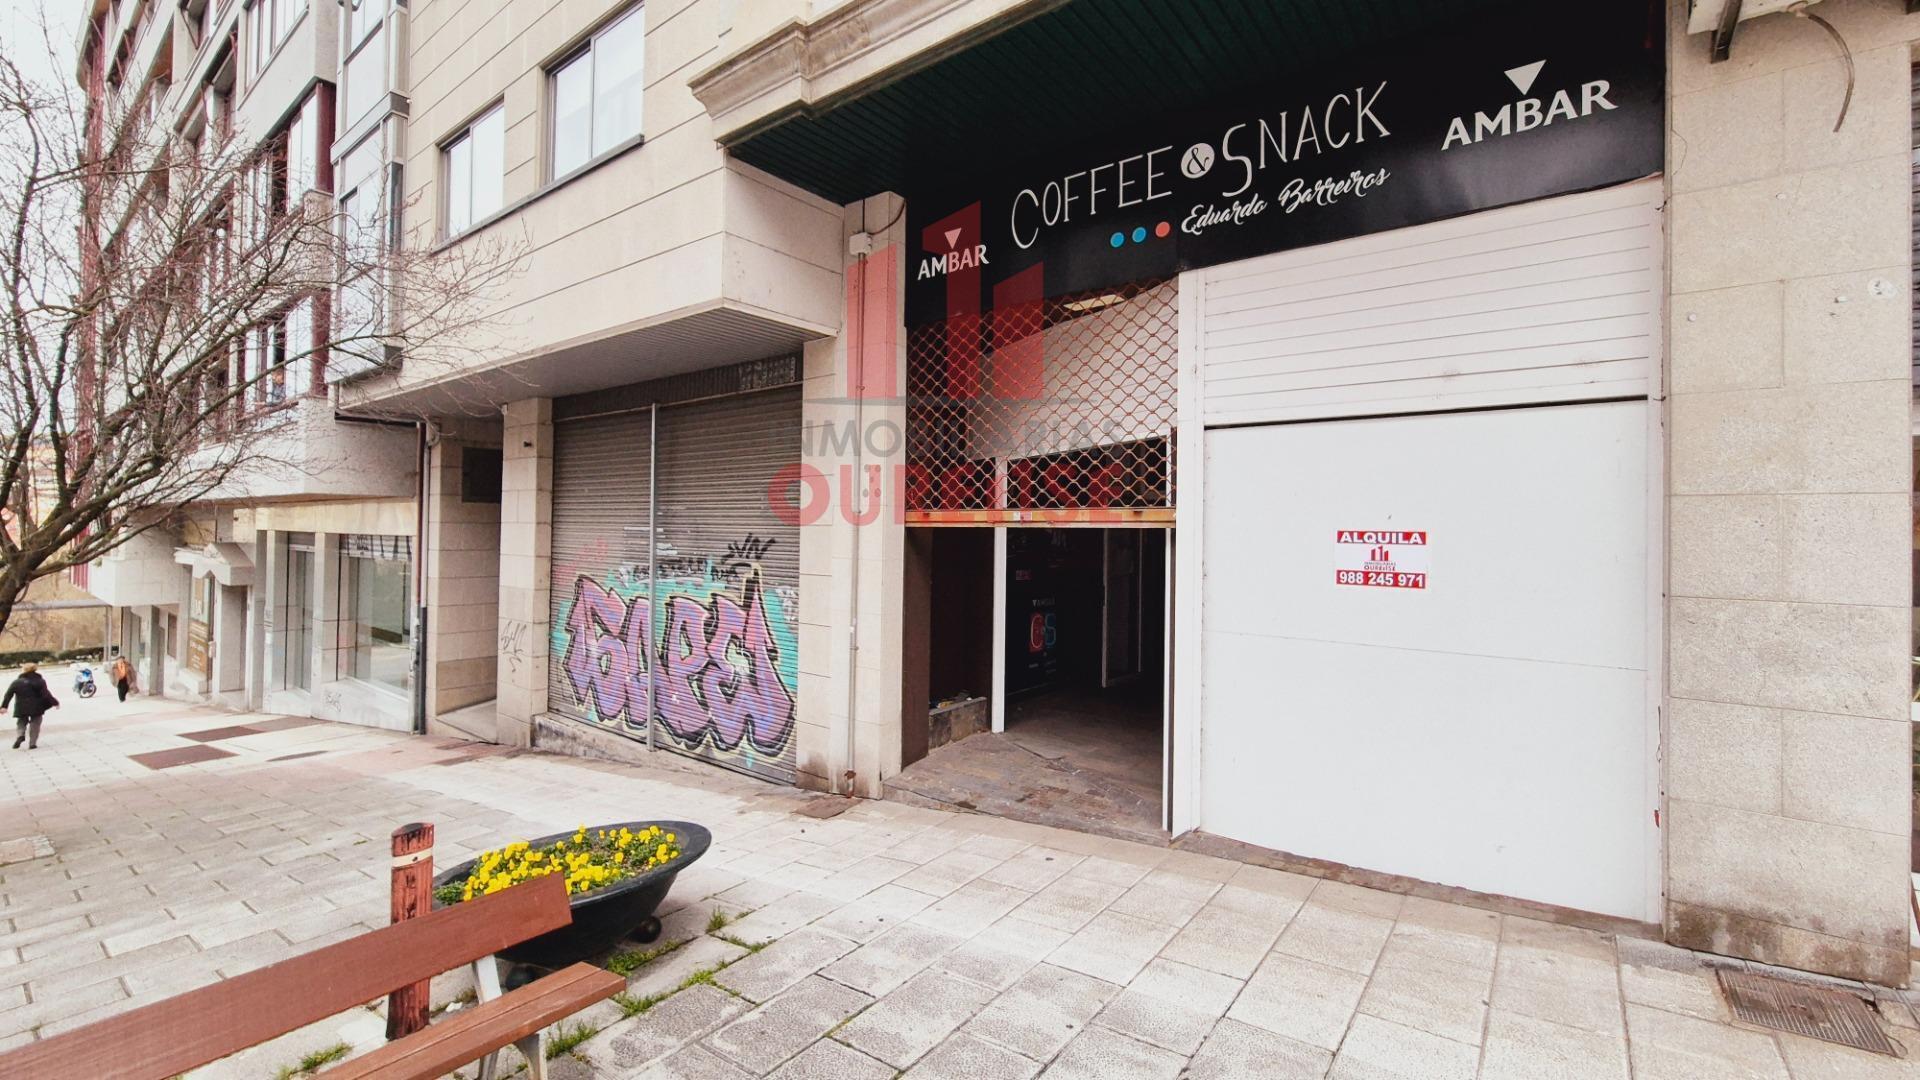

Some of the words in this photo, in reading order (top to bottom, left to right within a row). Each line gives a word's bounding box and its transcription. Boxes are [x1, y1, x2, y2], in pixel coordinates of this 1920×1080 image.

[1441, 80, 1619, 151] AMBAR
[1011, 145, 1173, 249] COFFEE
[1184, 145, 1212, 177] &
[1222, 80, 1391, 197] SNACK
[1181, 193, 1267, 236] Eduardo
[1278, 167, 1390, 214] Barreiros
[917, 244, 990, 281] AMBAR
[1340, 531, 1423, 544] ALQUILA
[1339, 571, 1364, 584] 988
[1367, 572, 1394, 585] 245
[1397, 573, 1423, 587] 971
